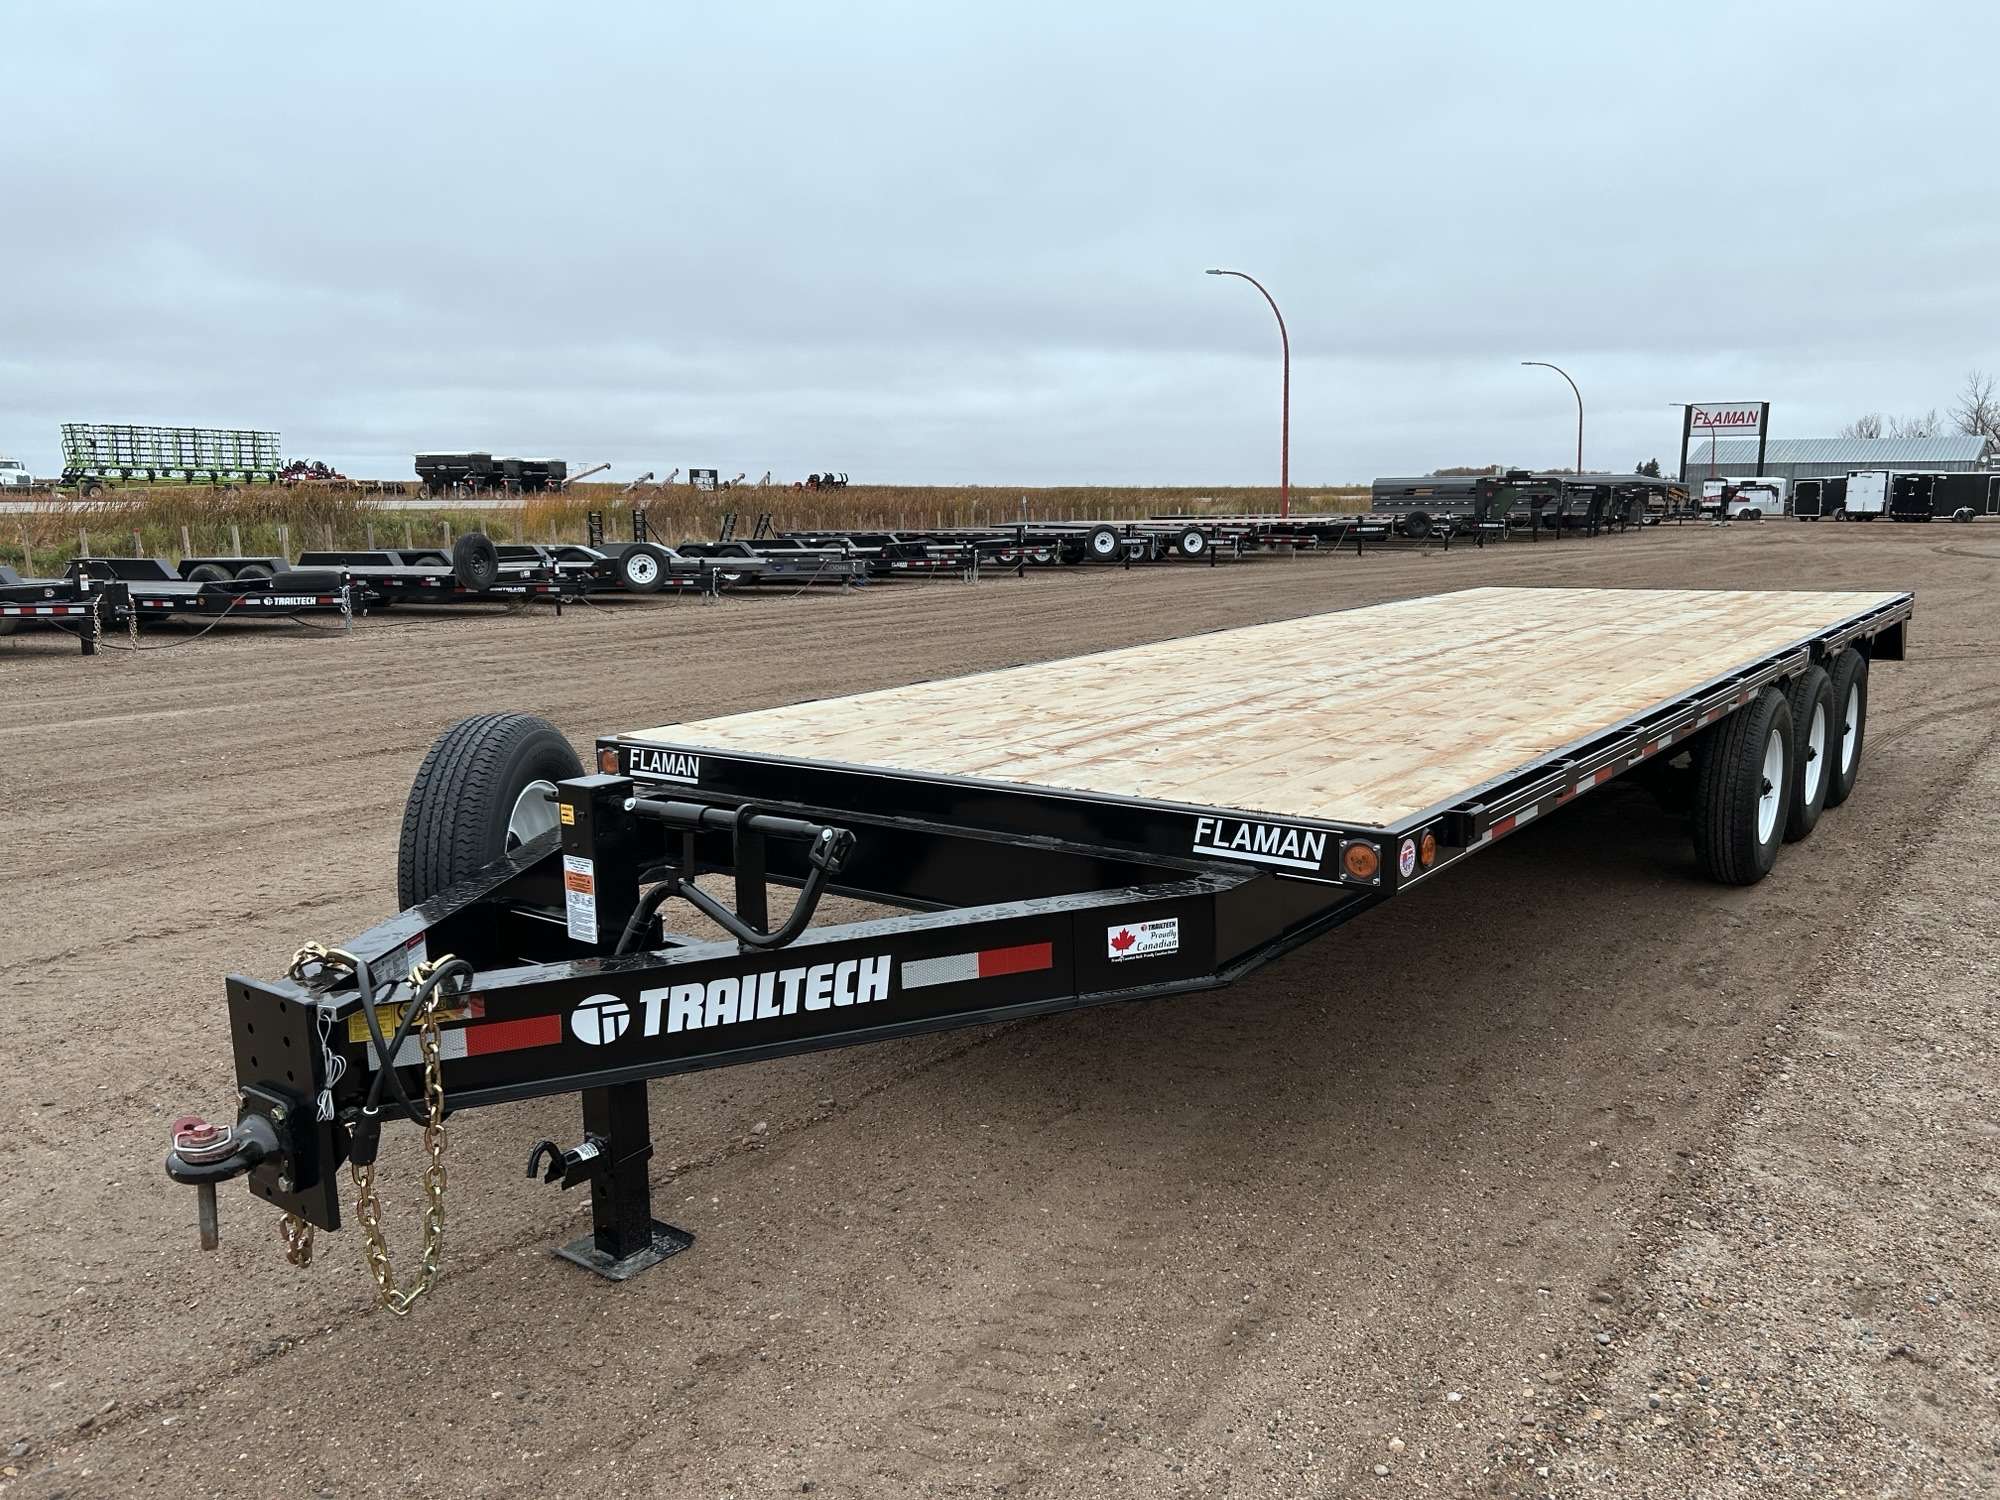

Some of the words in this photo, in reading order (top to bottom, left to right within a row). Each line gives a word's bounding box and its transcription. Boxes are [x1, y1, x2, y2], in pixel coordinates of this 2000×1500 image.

[1693, 411, 1758, 424] FLAMAN
[274, 597, 317, 606] TRAILTECH
[630, 749, 700, 778] FLAMAN
[1194, 817, 1327, 861] FLAMAN
[1151, 930, 1177, 939] Proudly
[1137, 939, 1177, 952] Canadian
[640, 954, 892, 1037] TRAILTECH
